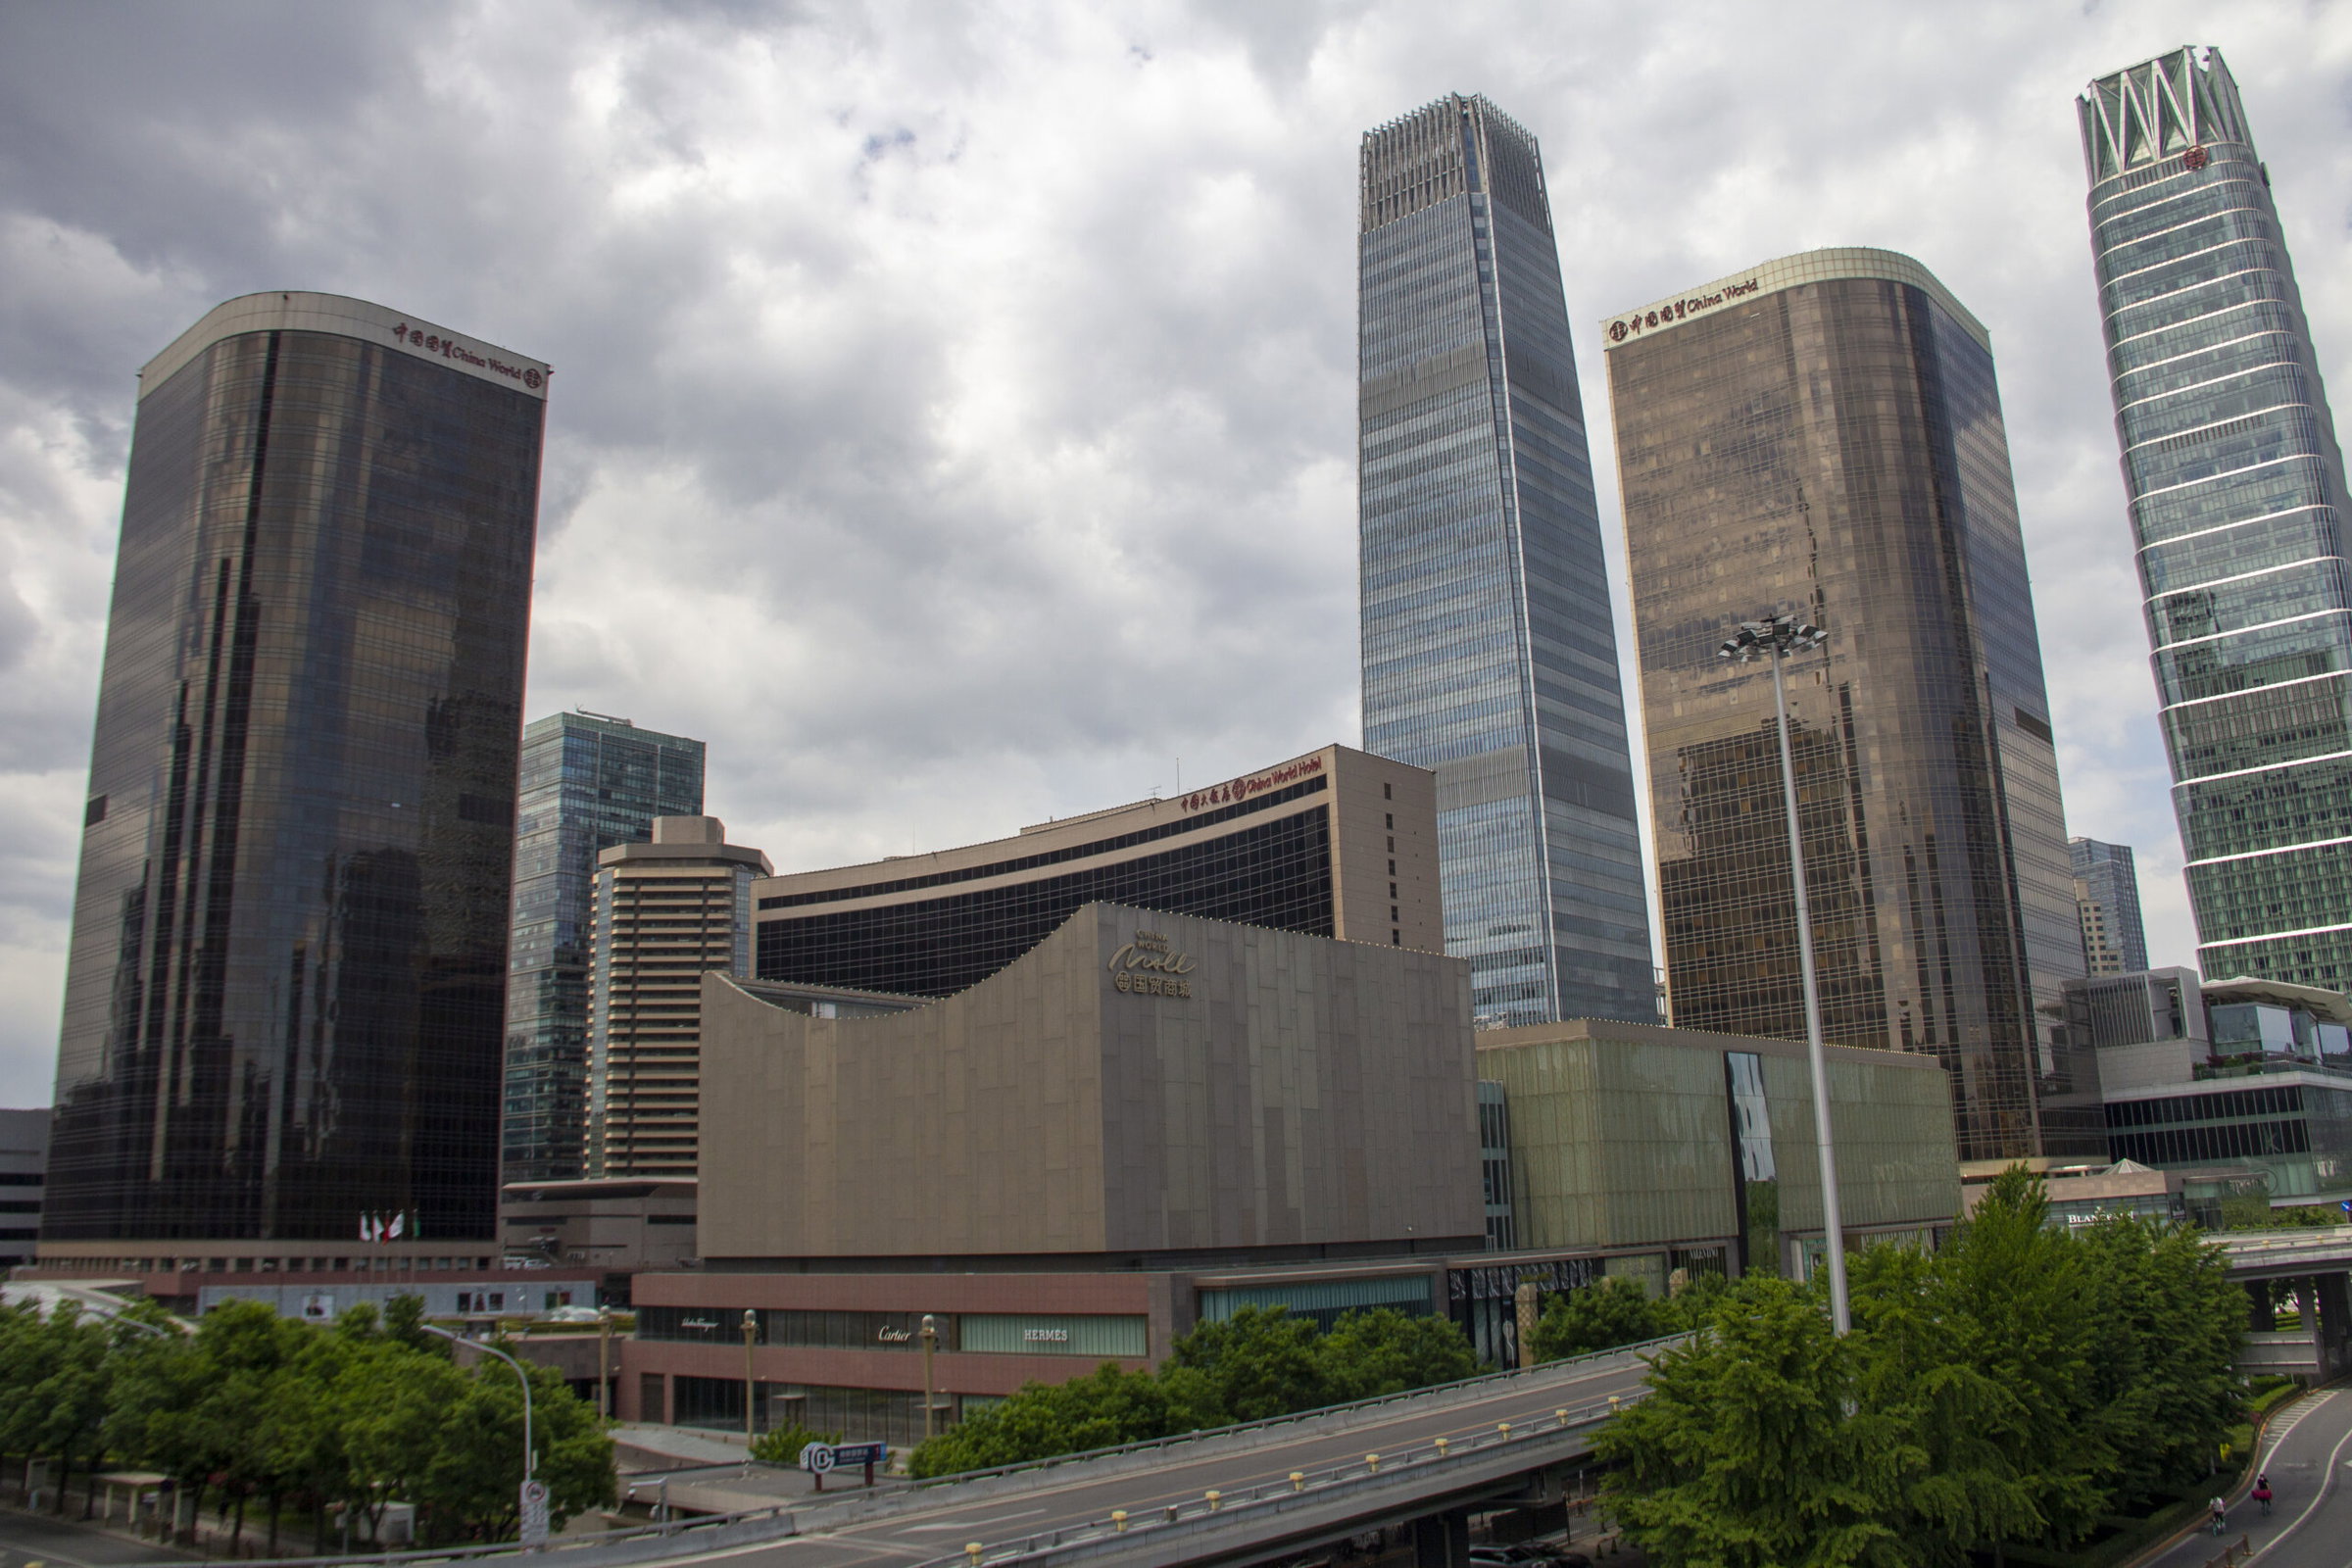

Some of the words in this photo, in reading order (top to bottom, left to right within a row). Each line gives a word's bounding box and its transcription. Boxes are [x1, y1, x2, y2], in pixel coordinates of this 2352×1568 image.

[1687, 295, 1723, 314] China
[1722, 278, 1759, 300] World
[452, 346, 486, 368] China
[488, 358, 521, 380] World
[1247, 777, 1272, 793] China
[1271, 764, 1298, 785] World
[1298, 756, 1322, 777] Hotel
[1137, 929, 1168, 941] CHINA
[1137, 941, 1168, 953] WORLD
[1134, 974, 1193, 998] 国贸商城
[878, 1325, 911, 1342] Cartier
